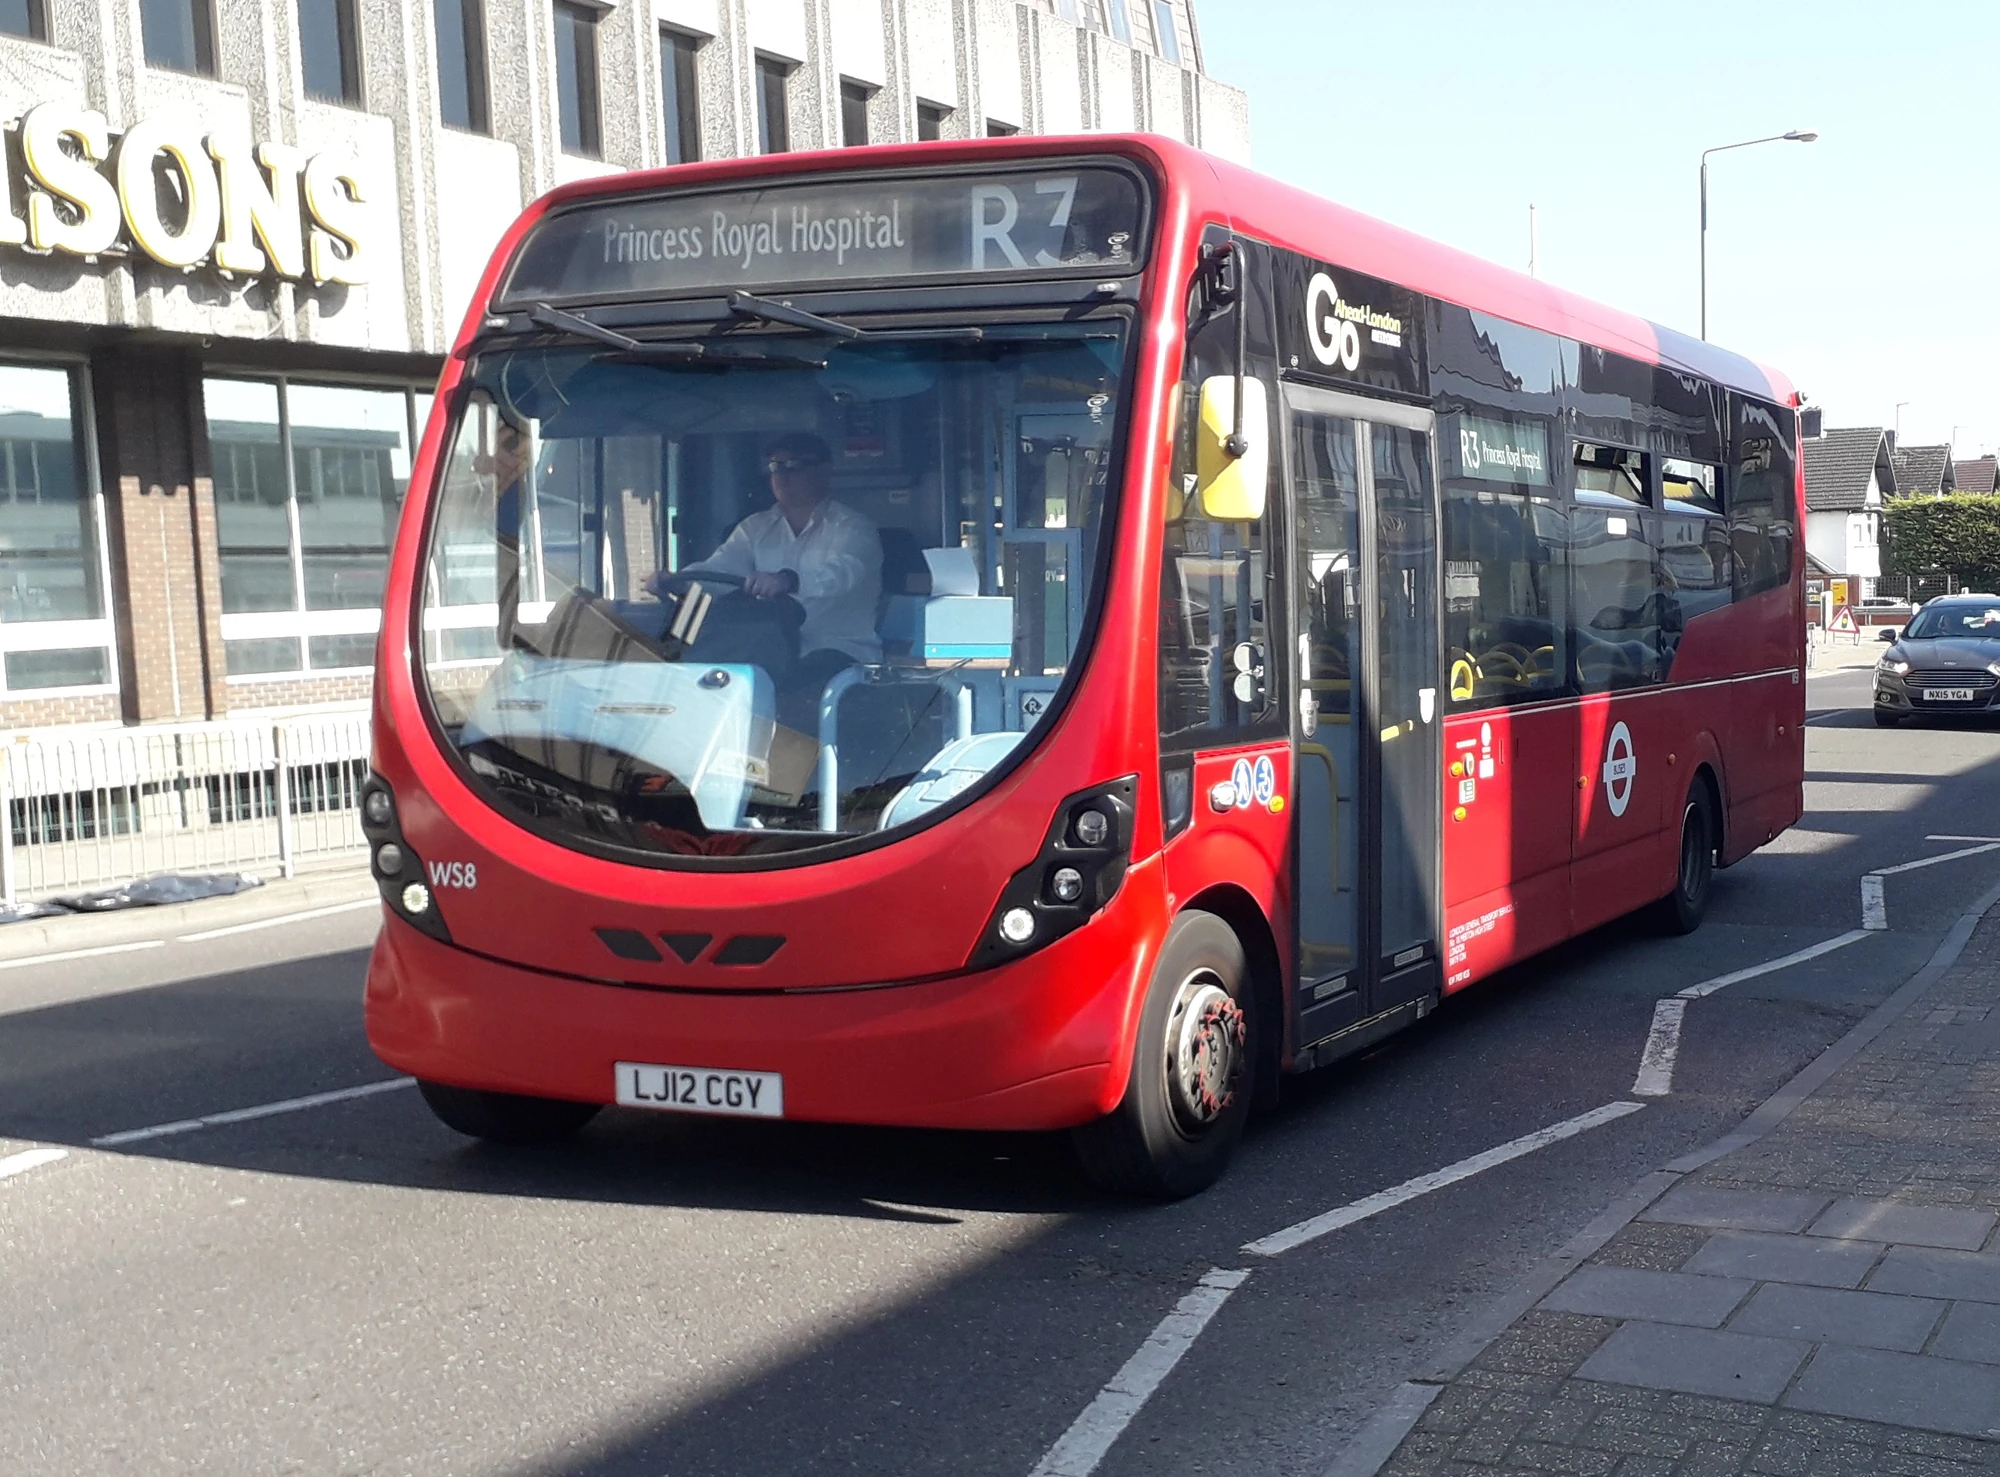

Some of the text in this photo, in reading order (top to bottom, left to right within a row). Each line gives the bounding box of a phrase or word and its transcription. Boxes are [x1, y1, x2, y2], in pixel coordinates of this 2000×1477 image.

[0, 100, 382, 286] SONS
[604, 218, 702, 263] Princess
[712, 210, 783, 269] Royal
[791, 199, 905, 266] Hospital
[971, 176, 1079, 270] R3
[1306, 272, 1360, 371] Go
[1460, 428, 1480, 469] R3
[1481, 440, 1505, 465] Princess
[1505, 444, 1521, 472] Royal
[1928, 690, 1968, 699] NX15 YGA
[429, 860, 477, 889] WS8
[634, 1069, 762, 1109] LJ12 CGY
